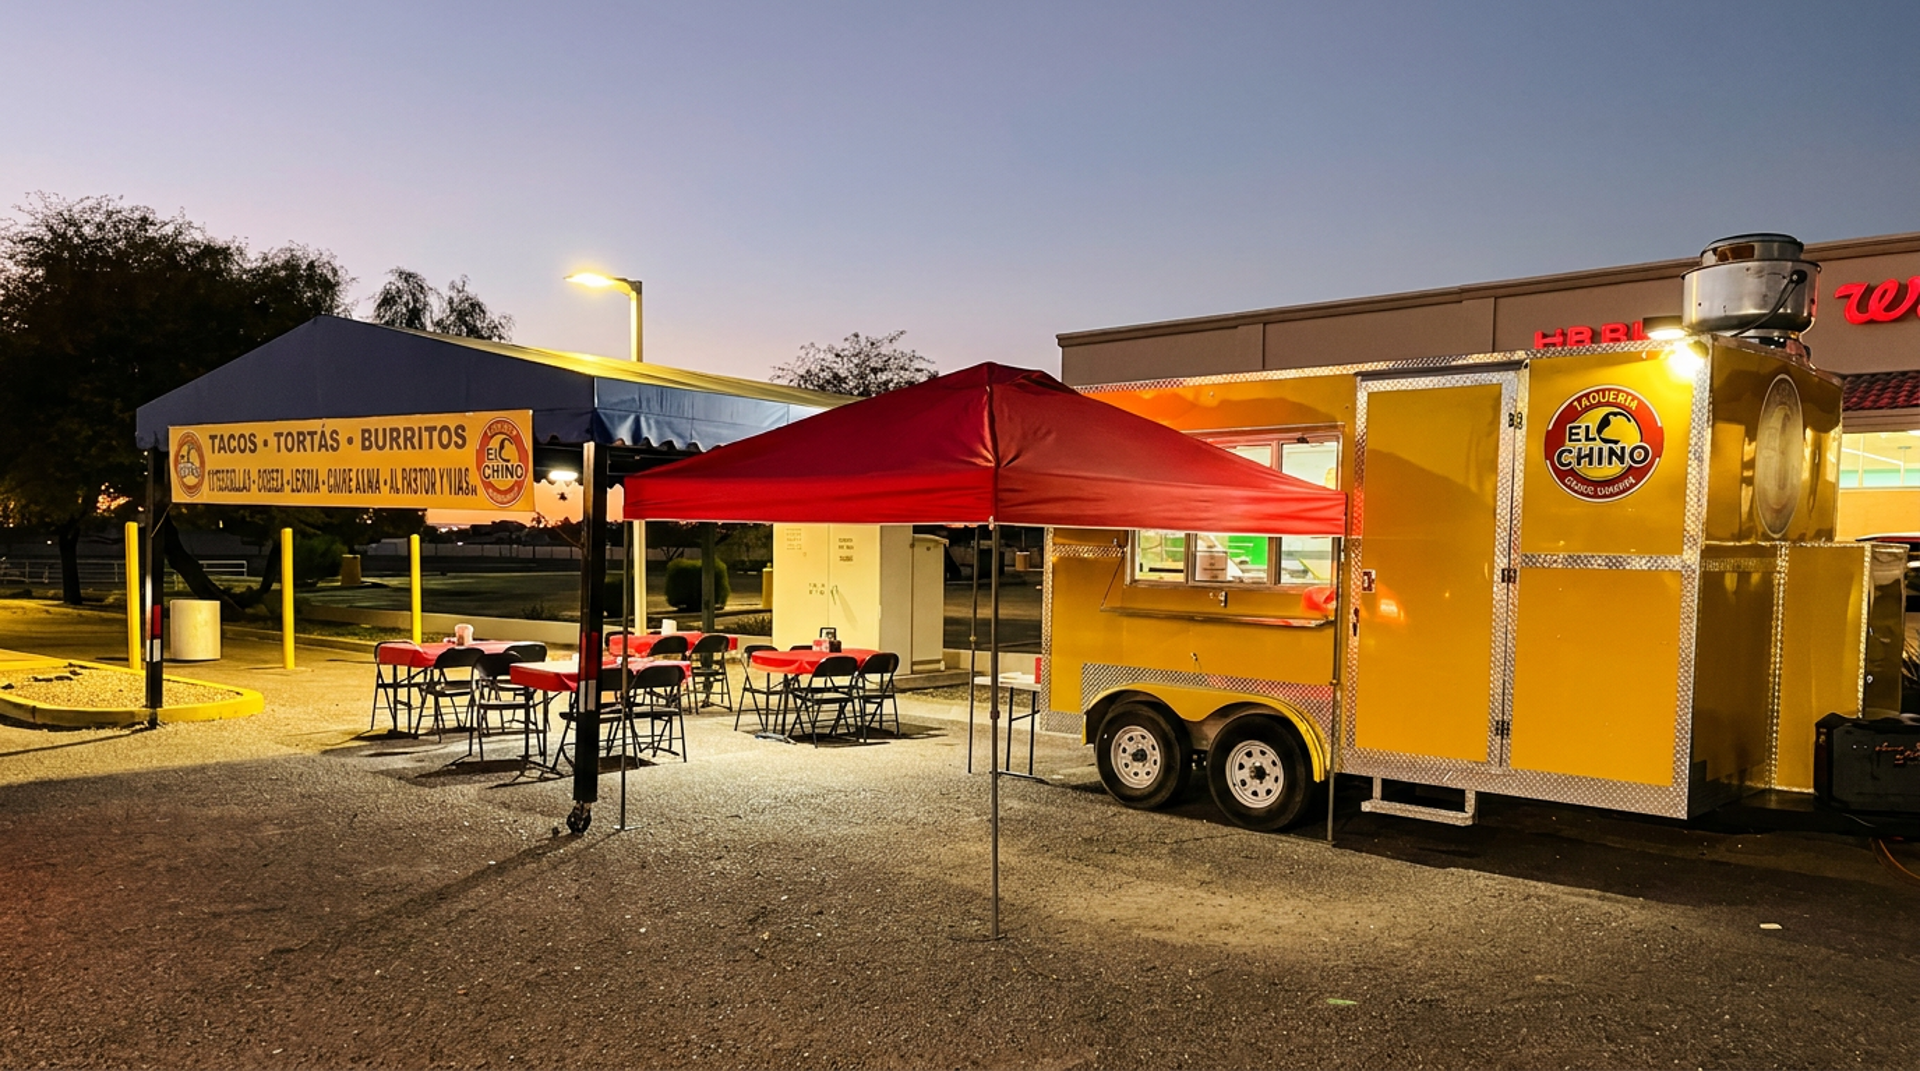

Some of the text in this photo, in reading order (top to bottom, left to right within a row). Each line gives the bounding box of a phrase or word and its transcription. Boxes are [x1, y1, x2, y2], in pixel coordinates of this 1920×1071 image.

[1834, 275, 1920, 325] W
[209, 432, 258, 454] TACOS
[361, 424, 467, 451] BURRITOS
[1567, 424, 1597, 443] EL
[1556, 444, 1651, 469] CHINO
[482, 463, 524, 480] CHINO
